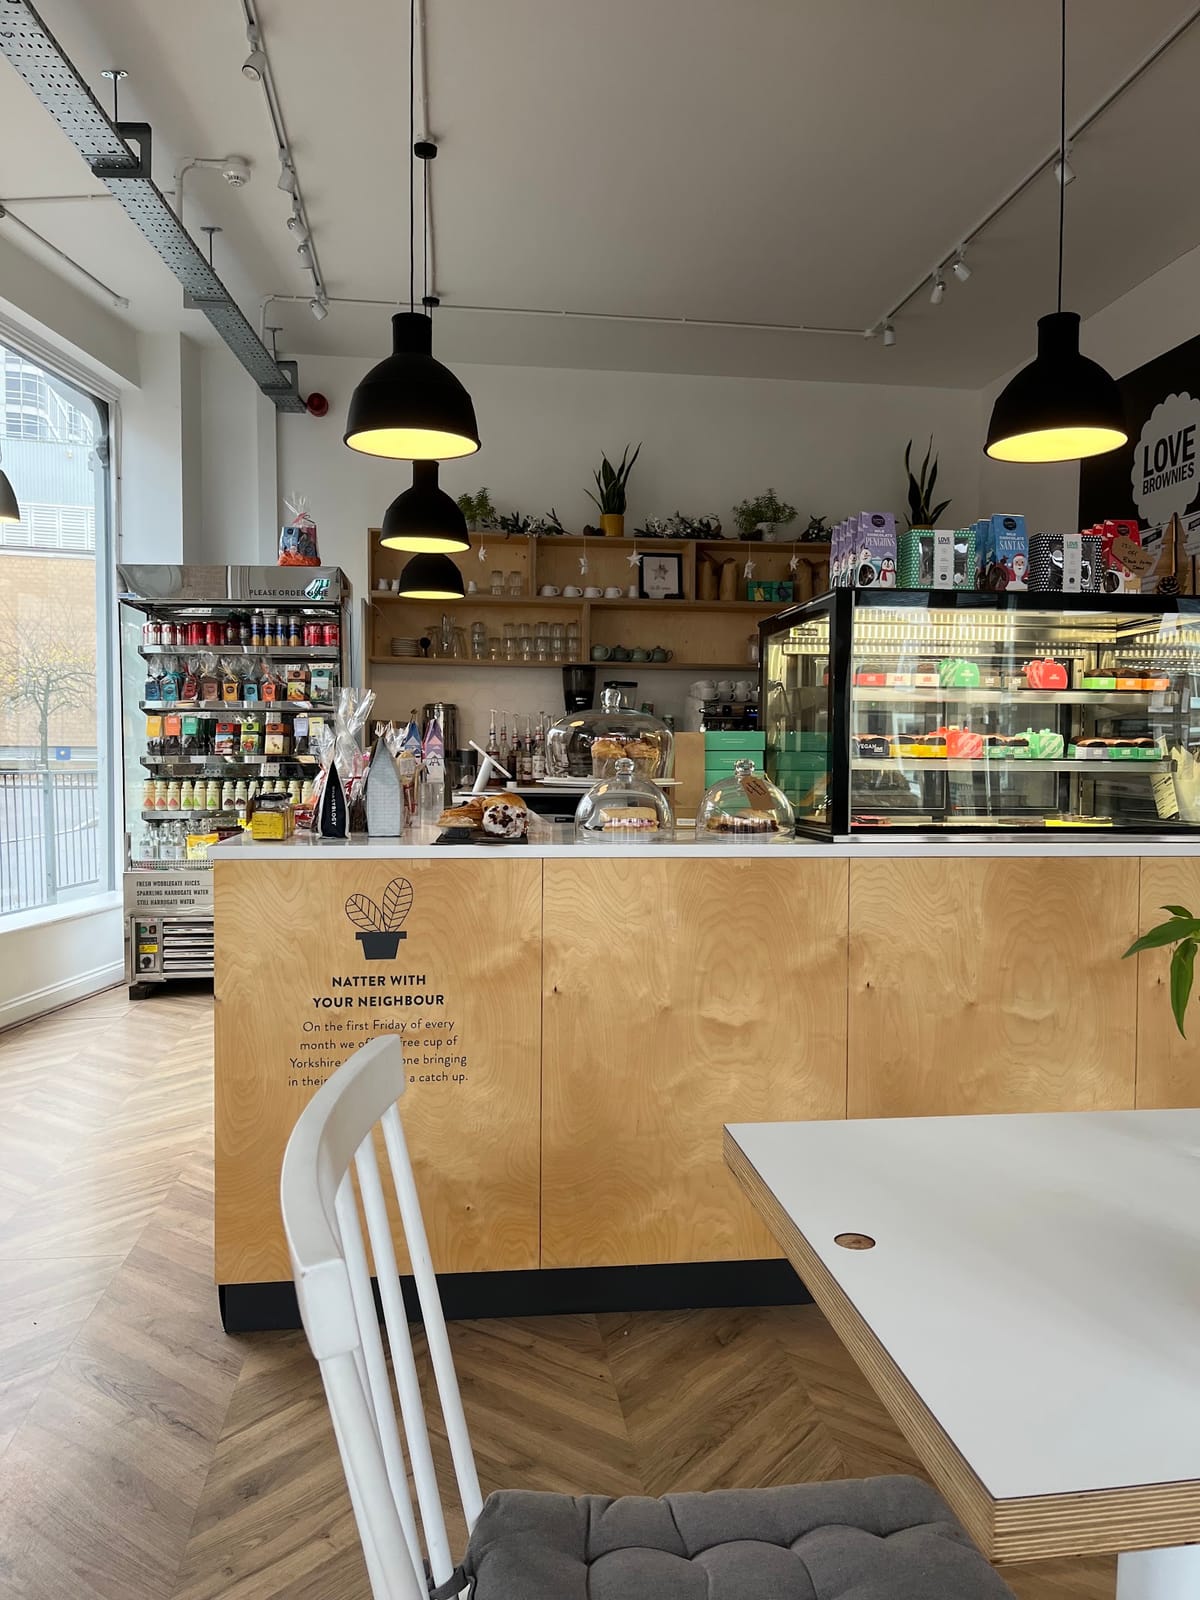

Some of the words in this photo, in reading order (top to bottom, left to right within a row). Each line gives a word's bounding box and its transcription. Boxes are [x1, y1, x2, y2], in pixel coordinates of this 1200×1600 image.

[1143, 424, 1196, 479] LOVE
[1142, 461, 1195, 496] BROWNIES
[865, 536, 896, 547] PENGUINS
[999, 540, 1025, 551] SANTAS
[250, 589, 277, 597] PLEASE
[278, 589, 306, 597] ORDER
[332, 975, 386, 987] NATTER
[390, 974, 426, 986] WITH
[312, 997, 353, 1009] YOUR
[358, 994, 445, 1008] NEIGHBOUR
[302, 1021, 321, 1032] On
[324, 1020, 343, 1031] the
[346, 1020, 369, 1031] first
[373, 1018, 408, 1033] Friday
[410, 1018, 422, 1030] of
[425, 1019, 455, 1032] every
[300, 1040, 336, 1050] month
[340, 1041, 355, 1049] we
[423, 1038, 443, 1050] cup
[446, 1035, 459, 1047] of
[289, 1057, 341, 1069] Yorkshire
[423, 1053, 468, 1068] bringing
[288, 1076, 298, 1087] in
[409, 1075, 416, 1083] a
[419, 1072, 449, 1083] catch
[452, 1072, 469, 1085] up.
